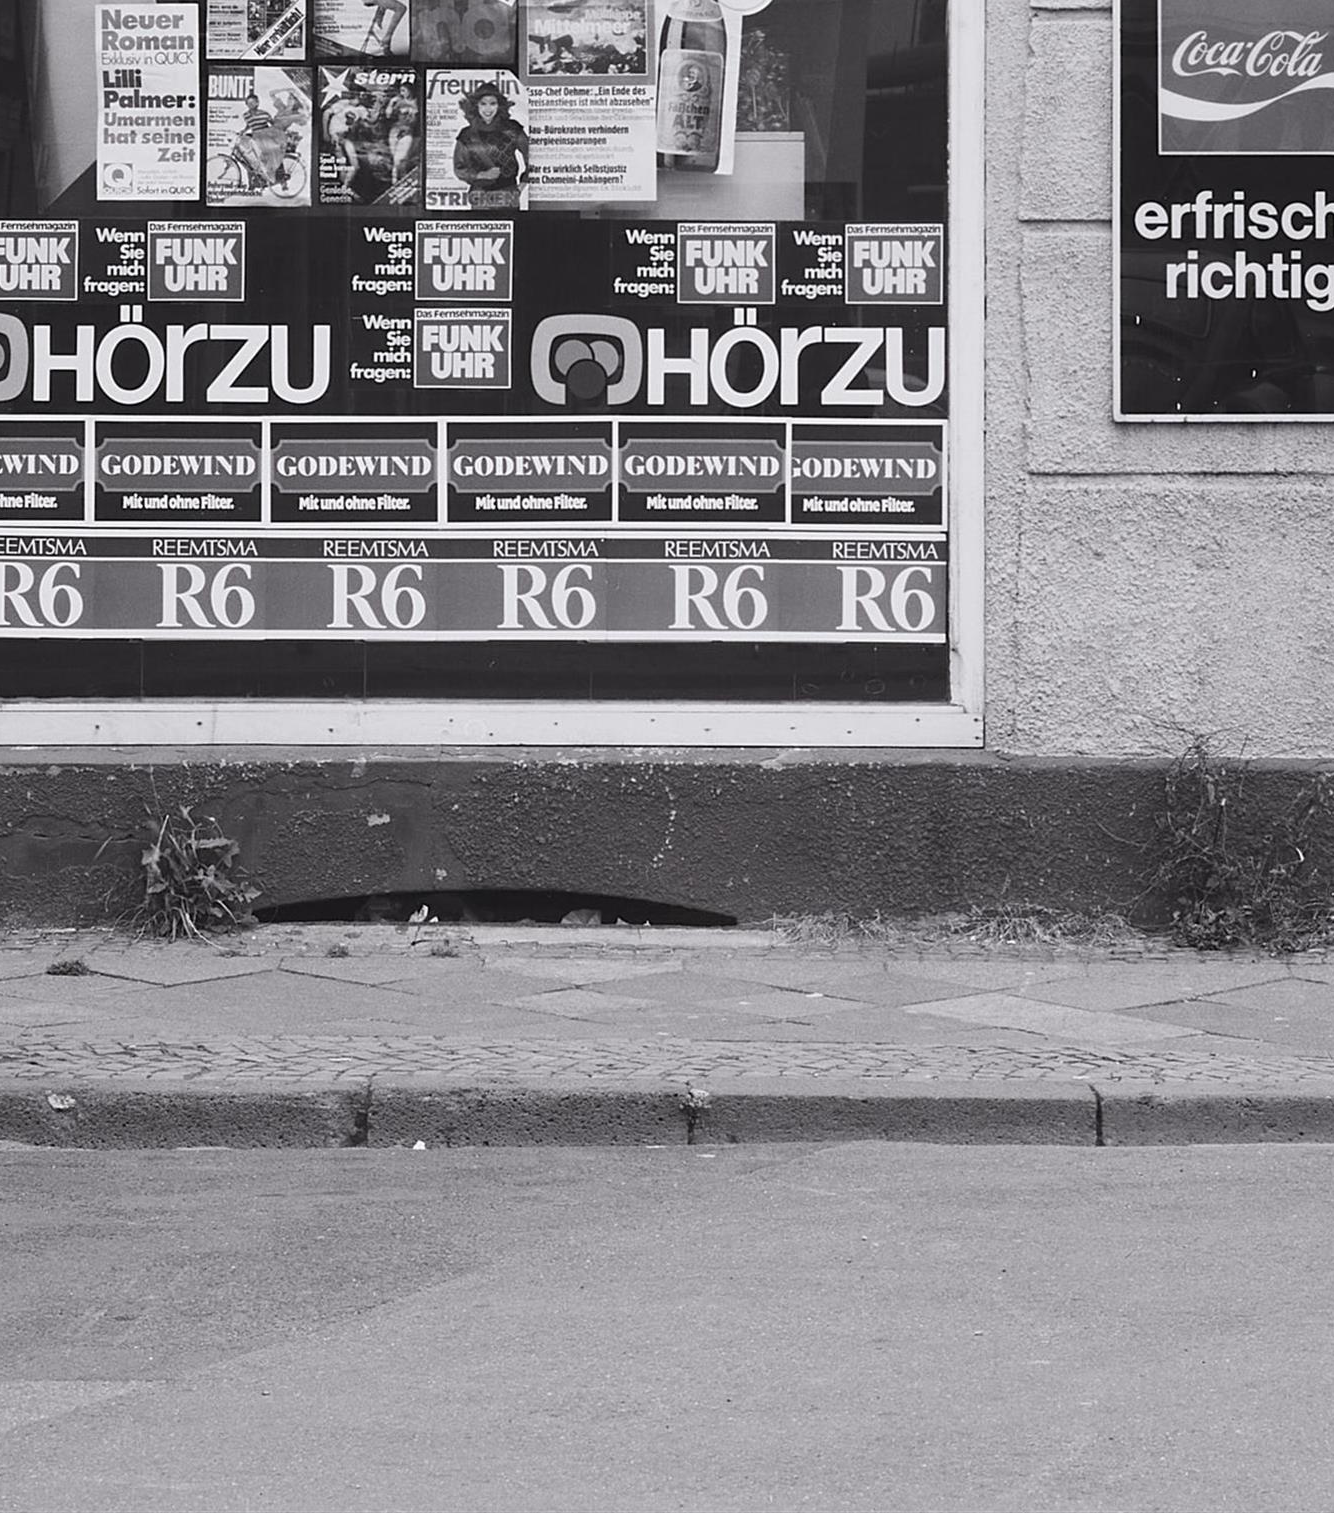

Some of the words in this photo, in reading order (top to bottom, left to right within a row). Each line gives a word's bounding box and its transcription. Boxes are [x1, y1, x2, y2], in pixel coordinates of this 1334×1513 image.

[101, 9, 184, 30] Neuer
[102, 30, 194, 51] Roman
[101, 52, 140, 65] Exklusiv
[144, 52, 153, 65] in
[154, 51, 194, 65] QUICK
[1171, 30, 1329, 78] Coca-Cola
[102, 68, 142, 88] Lilli
[354, 69, 415, 85] stern
[427, 71, 520, 99] freundin
[208, 75, 255, 99] BUNTE
[611, 86, 630, 95] Ende
[632, 86, 646, 95] des
[103, 89, 196, 109] Palmer:
[578, 98, 588, 106] ist
[589, 98, 608, 106] nicht
[103, 112, 196, 127] Umarmen
[103, 127, 138, 144] hat
[141, 128, 195, 144] seine
[588, 124, 629, 134] verhindern
[157, 146, 196, 163] Zeit
[553, 164, 582, 173] wirklich
[583, 164, 627, 174] Selbstjustiz
[137, 186, 159, 195] Sofort
[160, 186, 168, 195] in
[168, 186, 195, 195] QUICK
[427, 191, 519, 207] STRICKEN
[0, 222, 77, 232] Fernsehmagazin
[95, 228, 145, 243] Wenn
[149, 223, 165, 231] Das
[167, 223, 243, 232] Fernsehmagazin
[363, 227, 413, 242] Wenn
[417, 222, 434, 231] Das
[436, 222, 511, 232] Fernsehmagazin
[679, 225, 696, 233] Das
[697, 225, 773, 234] Fernsehmagazin
[847, 226, 863, 234] Das
[865, 226, 942, 235] Fernsehmagazin
[625, 229, 675, 245] Wenn
[793, 231, 843, 246] Wenn
[119, 244, 145, 260] Sie
[155, 238, 237, 265] FUNK
[387, 243, 413, 259] Sie
[423, 237, 506, 264] FUNK
[650, 246, 675, 262] Sie
[686, 240, 768, 267] FUNK
[818, 246, 843, 263] Sie
[853, 241, 936, 268] FUNK
[106, 260, 145, 277] mich
[375, 259, 413, 275] mich
[637, 262, 675, 278] mich
[804, 264, 843, 280] mich
[83, 277, 145, 296] fragen:
[164, 265, 228, 292] UHR
[351, 275, 413, 295] fragen:
[432, 264, 496, 292] UHR
[694, 267, 759, 295] UHR
[862, 267, 926, 296] UHR
[614, 278, 675, 298] fragen:
[781, 279, 843, 299] fragen:
[362, 315, 412, 330] Wenn
[416, 310, 432, 319] Das
[434, 310, 509, 319] Fernsehmagazin
[386, 331, 412, 347] Sie
[422, 325, 505, 352] FUNK
[373, 347, 412, 363] mich
[350, 363, 412, 383] fragen:
[431, 352, 495, 380] UHR
[101, 454, 256, 475] GODEWIND
[276, 455, 432, 476] GODEWIND
[453, 455, 608, 476] GODEWIND
[624, 455, 780, 476] GODEWIND
[25, 492, 58, 509] Filter.
[299, 494, 319, 510] Mit
[321, 494, 344, 510] und
[345, 494, 375, 510] ohne
[377, 494, 411, 510] Filter.
[803, 497, 823, 513] Mit
[825, 497, 848, 513] und
[849, 497, 880, 513] ohne
[881, 497, 915, 513] Filter.
[152, 539, 258, 556] REEMTSMA
[323, 540, 429, 557] REEMTSMA
[493, 540, 599, 557] REEMTSMA
[664, 541, 771, 558] REEMTSMA
[832, 542, 938, 559] REEMTSMA
[156, 562, 255, 628] R6
[327, 563, 426, 629] R6
[497, 563, 596, 629] R6
[669, 564, 768, 630] R6
[836, 566, 936, 632] R6
